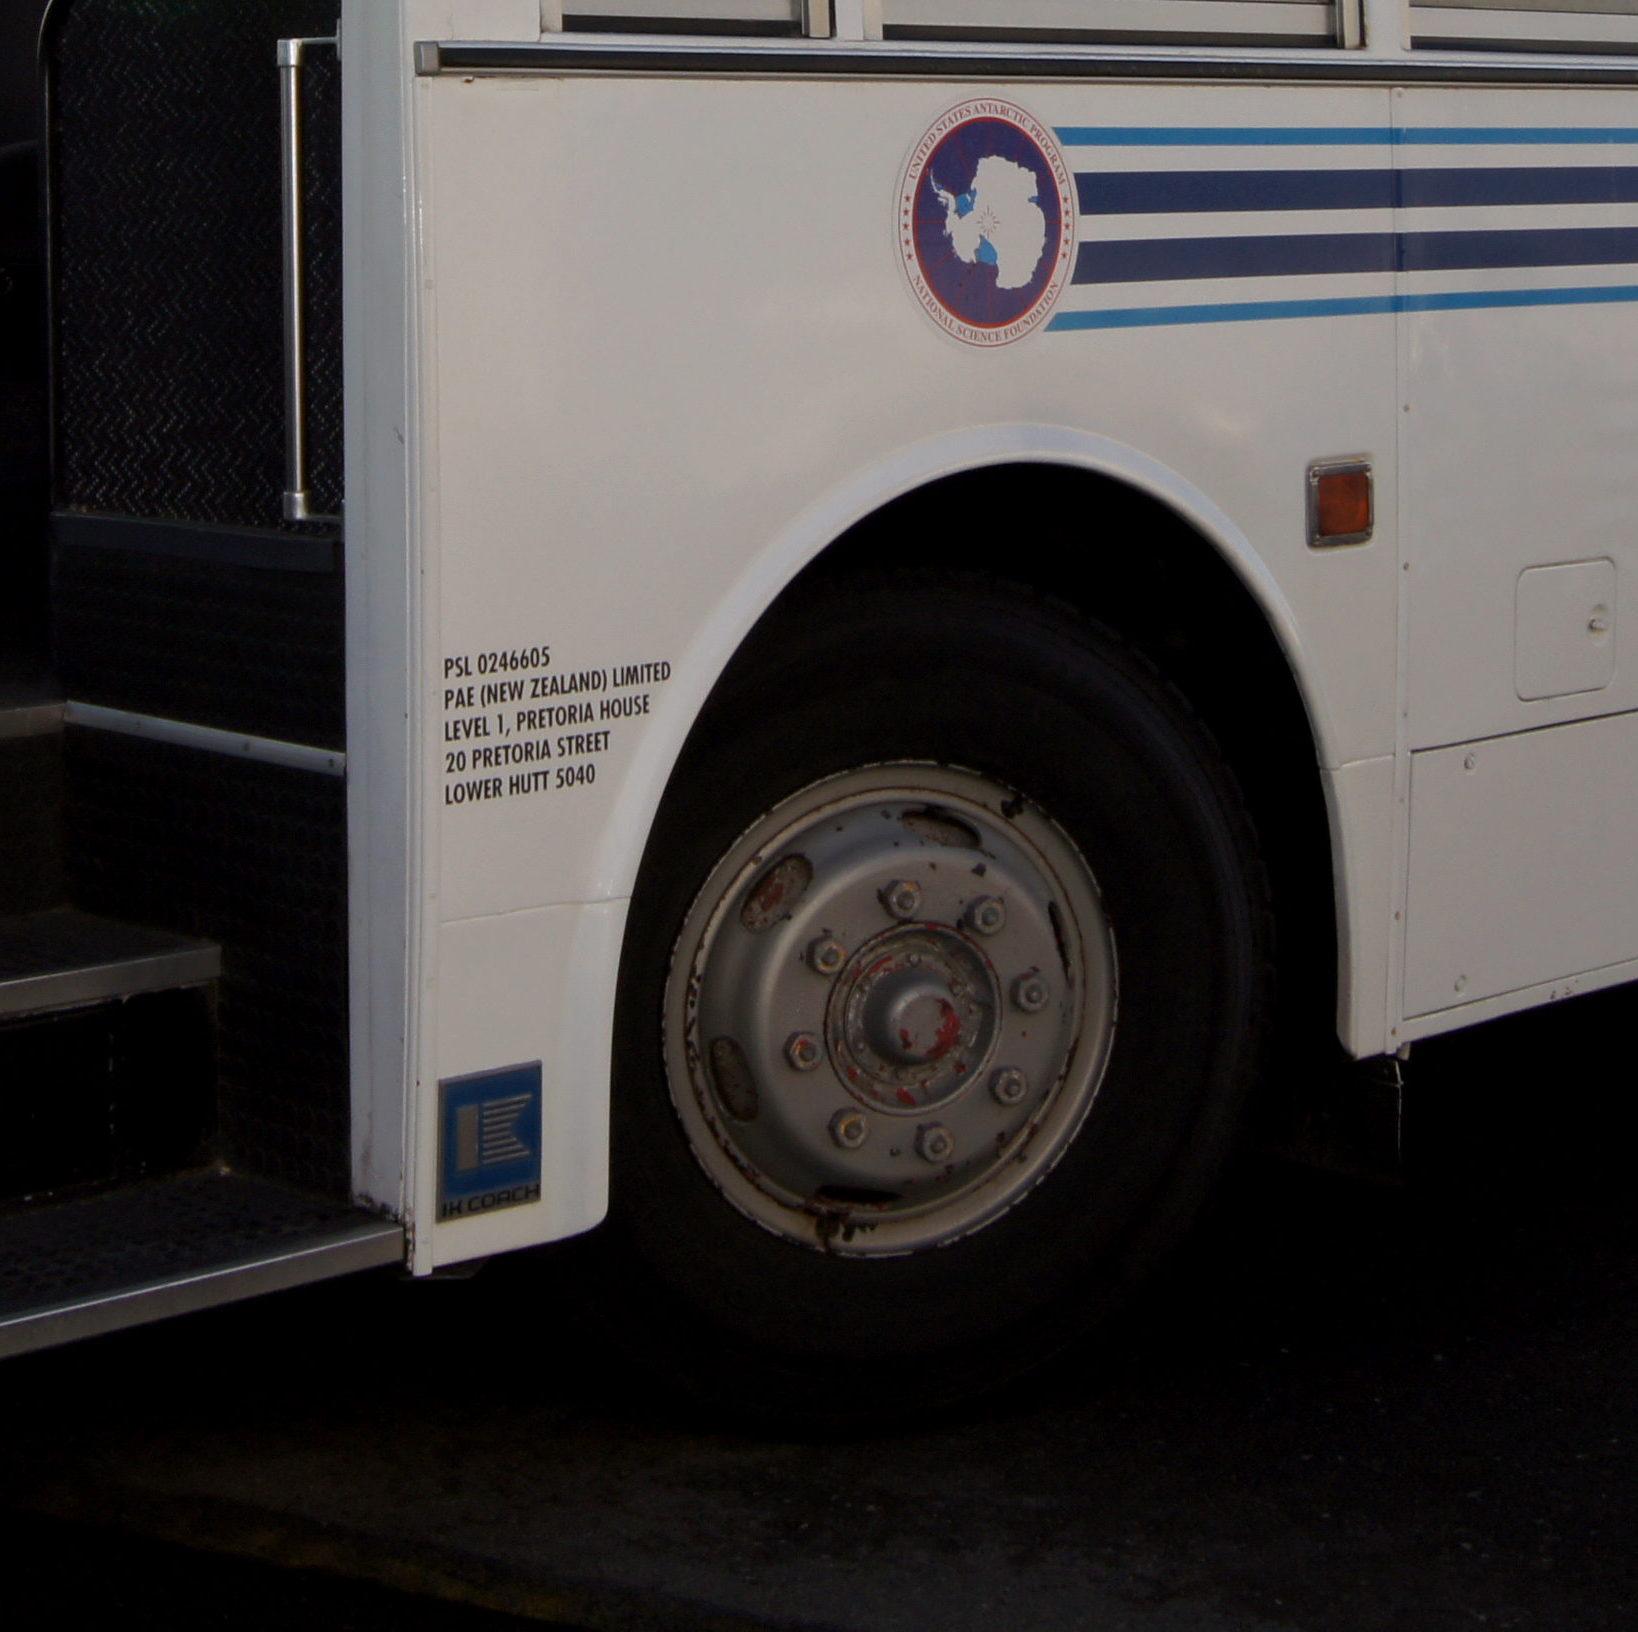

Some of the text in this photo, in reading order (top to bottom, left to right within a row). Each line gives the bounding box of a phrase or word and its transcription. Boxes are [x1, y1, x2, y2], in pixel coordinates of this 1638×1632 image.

[909, 102, 1067, 185] UNITED STATES ANTARCTIC PROGRAM
[914, 274, 1060, 343] NATIONAL SCIENCE FOUNDATION
[444, 646, 550, 679] PSL 0246605
[444, 660, 672, 710] PAE (NEW ZEALAND) LIMITED
[444, 694, 651, 743] LEVEL 1, PRETORIA HOUSE
[445, 729, 611, 774] 20 PRETORIA STREET
[444, 763, 596, 806] LOWER HUTT 5040
[467, 1183, 540, 1211] COACH
